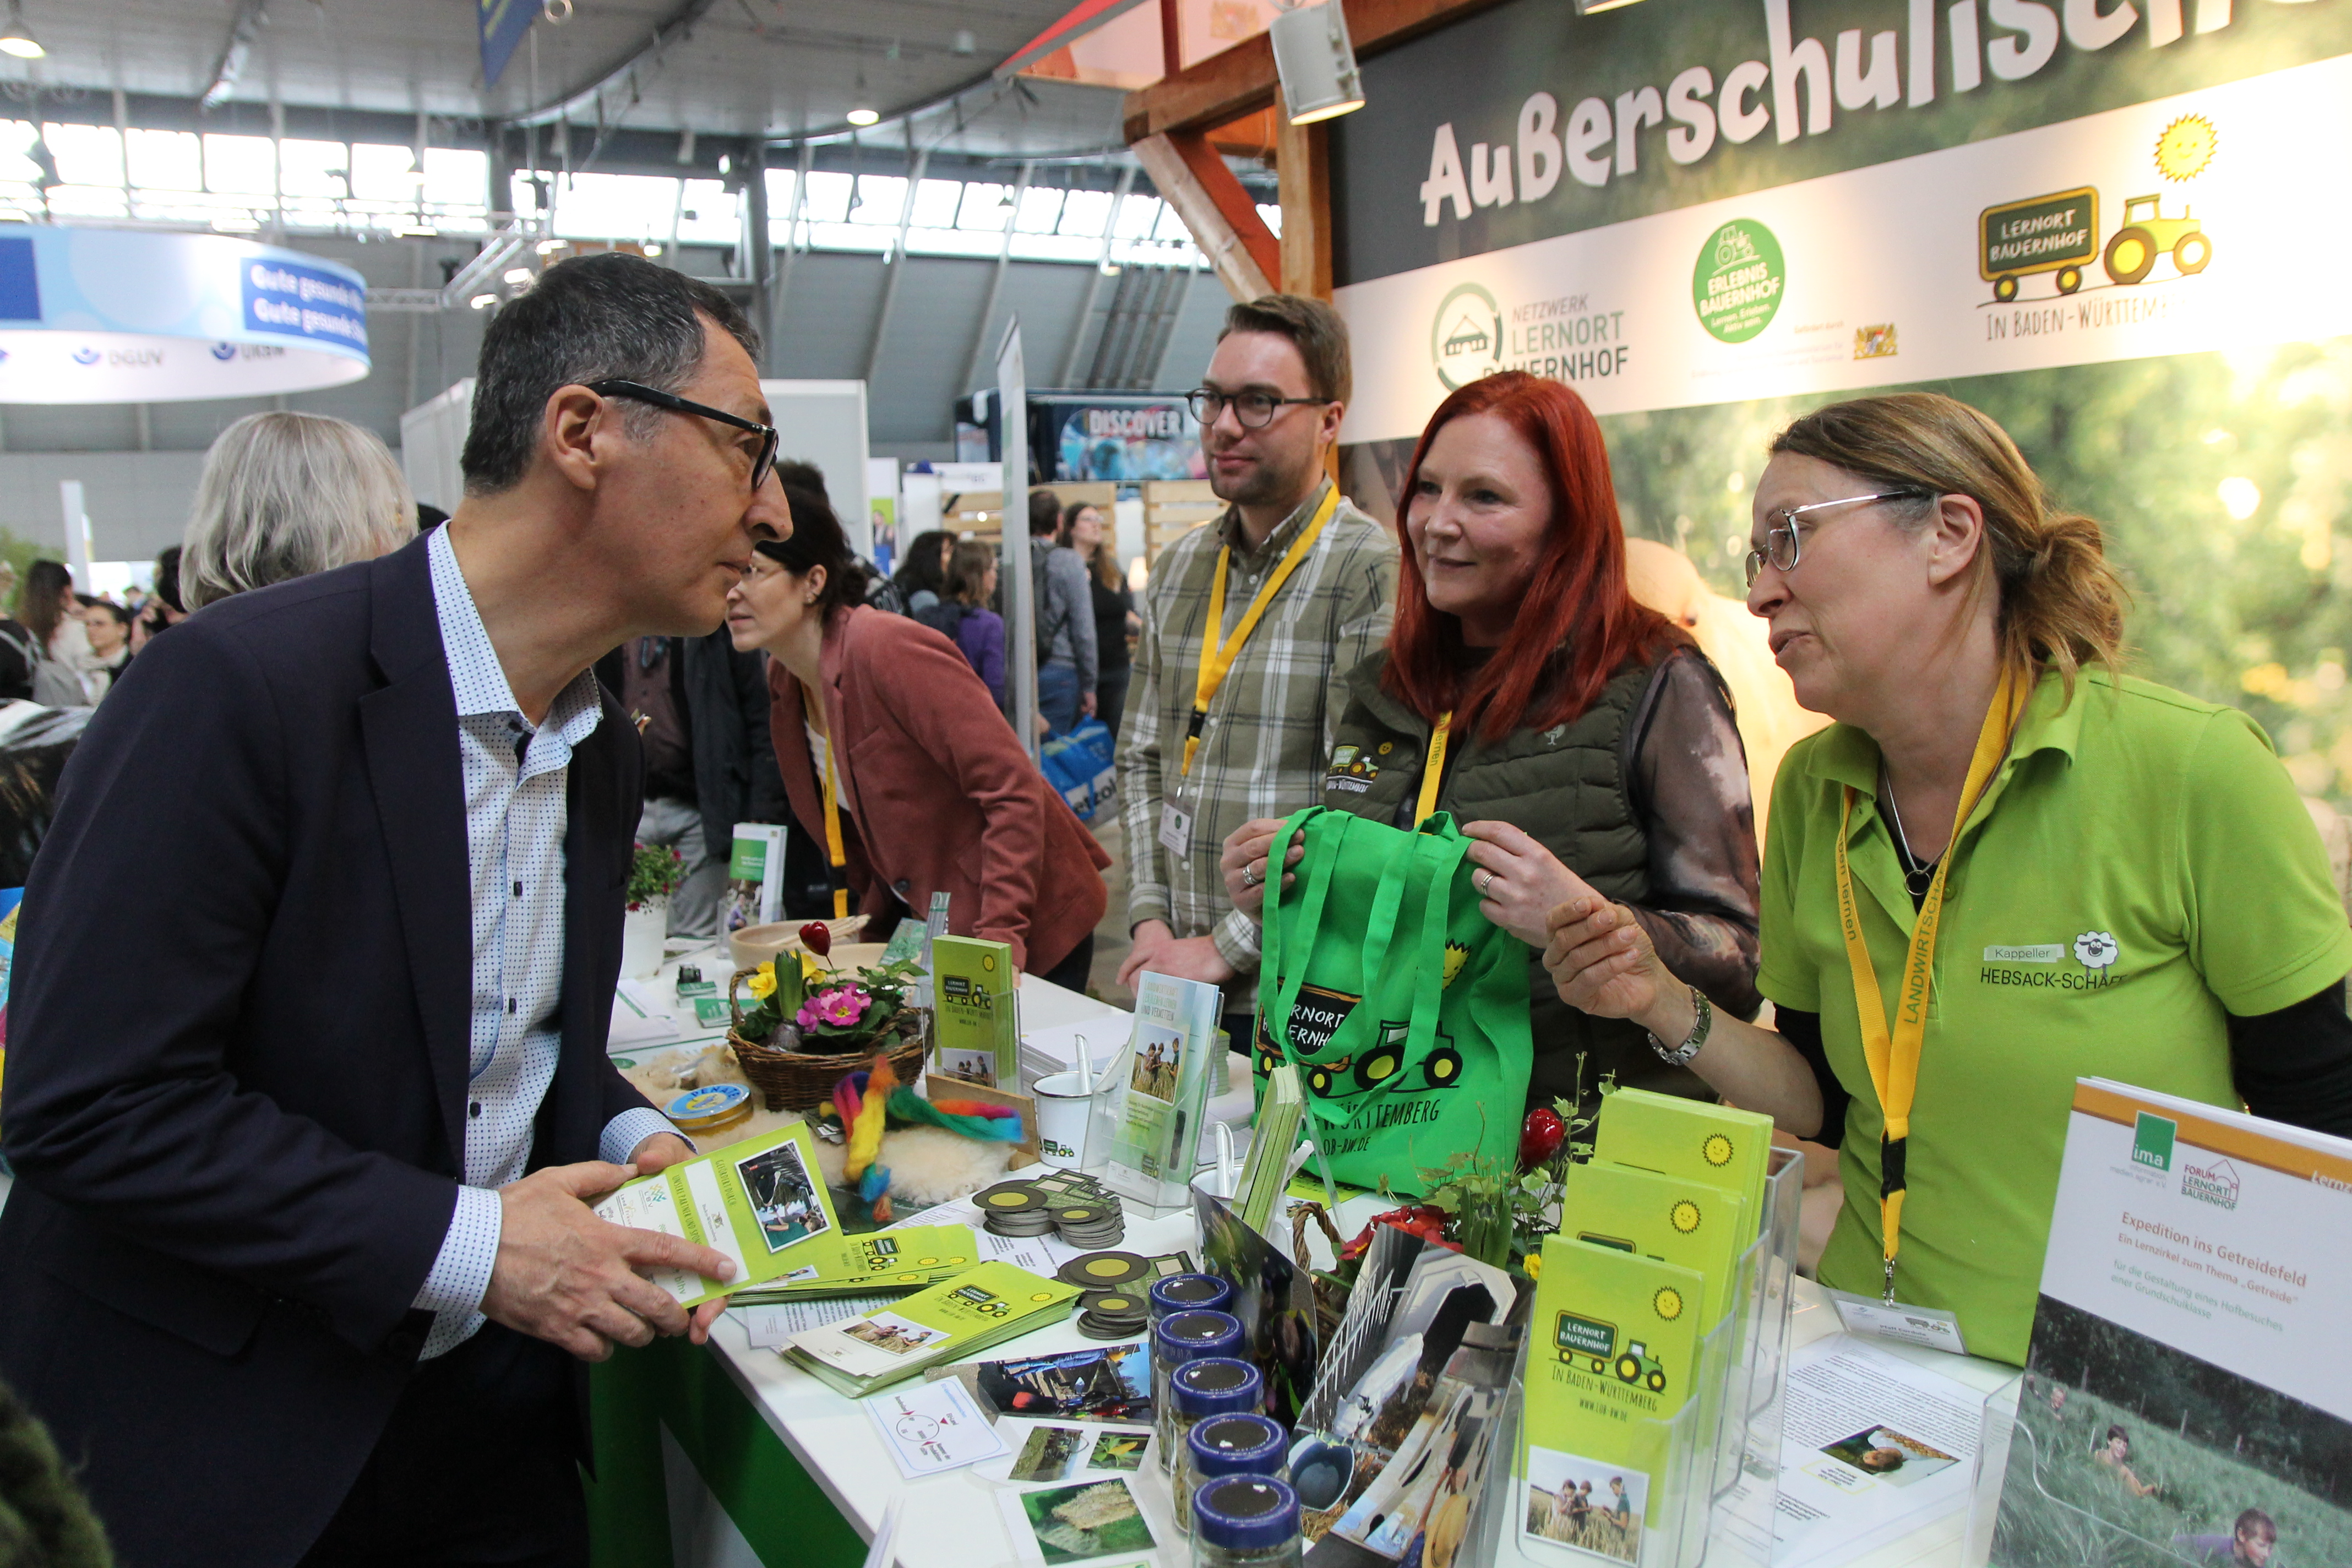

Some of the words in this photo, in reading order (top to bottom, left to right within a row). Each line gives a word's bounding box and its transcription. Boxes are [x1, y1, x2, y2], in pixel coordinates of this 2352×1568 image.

[1419, 0, 2321, 226] Außerschulisc
[2001, 209, 2077, 238] LERNORT
[1989, 228, 2089, 262] BAUERNHOF
[251, 264, 299, 296] Gute
[1707, 262, 1768, 296] ERLEBNIS
[1512, 293, 1589, 323] NETZWERK
[1700, 276, 1782, 317] BAUERNHOF
[253, 297, 302, 328] Gute
[1512, 309, 1625, 355] LERNORT
[1483, 344, 1630, 384] ERNHOF
[1088, 409, 1182, 438] DISCOVER
[1430, 731, 1446, 766] lernen
[1842, 883, 1856, 941] lernen
[1995, 948, 2050, 961] Kappeller
[1290, 1004, 1345, 1028] RNORT
[2132, 1144, 2164, 1167] ima
[672, 1174, 685, 1195] UNSERE
[716, 1159, 731, 1188] GEFÖRDERT
[2183, 1175, 2230, 1197] LERNORT
[2184, 1164, 2216, 1182] FORUM
[678, 1193, 692, 1218] PARTNER
[2181, 1186, 2236, 1212] BAUERNHOF
[685, 1216, 696, 1229] UND
[2117, 1233, 2133, 1246] Ein
[2135, 1239, 2180, 1264] Lernzirkel
[2182, 1259, 2203, 1271] zum
[2206, 1264, 2239, 1284] Thema
[2121, 1211, 2191, 1245] Expedition
[2193, 1235, 2213, 1254] ins
[2217, 1245, 2308, 1288] Getreidefeld
[2110, 1273, 2133, 1288] einer
[2135, 1282, 2212, 1320] Grundschulklasse
[2113, 1259, 2127, 1272] für
[2128, 1264, 2143, 1278] die
[2144, 1271, 2193, 1299] Gestaltung
[2195, 1292, 2219, 1308] eines
[2221, 1299, 2284, 1332] Hofbesuches
[1560, 1331, 1610, 1352] BAUERNHOF
[1567, 1322, 1606, 1340] LERNORT
[1552, 1365, 1564, 1382] IN
[1566, 1369, 1657, 1412] BADEN-WÜRTTEMBERG
